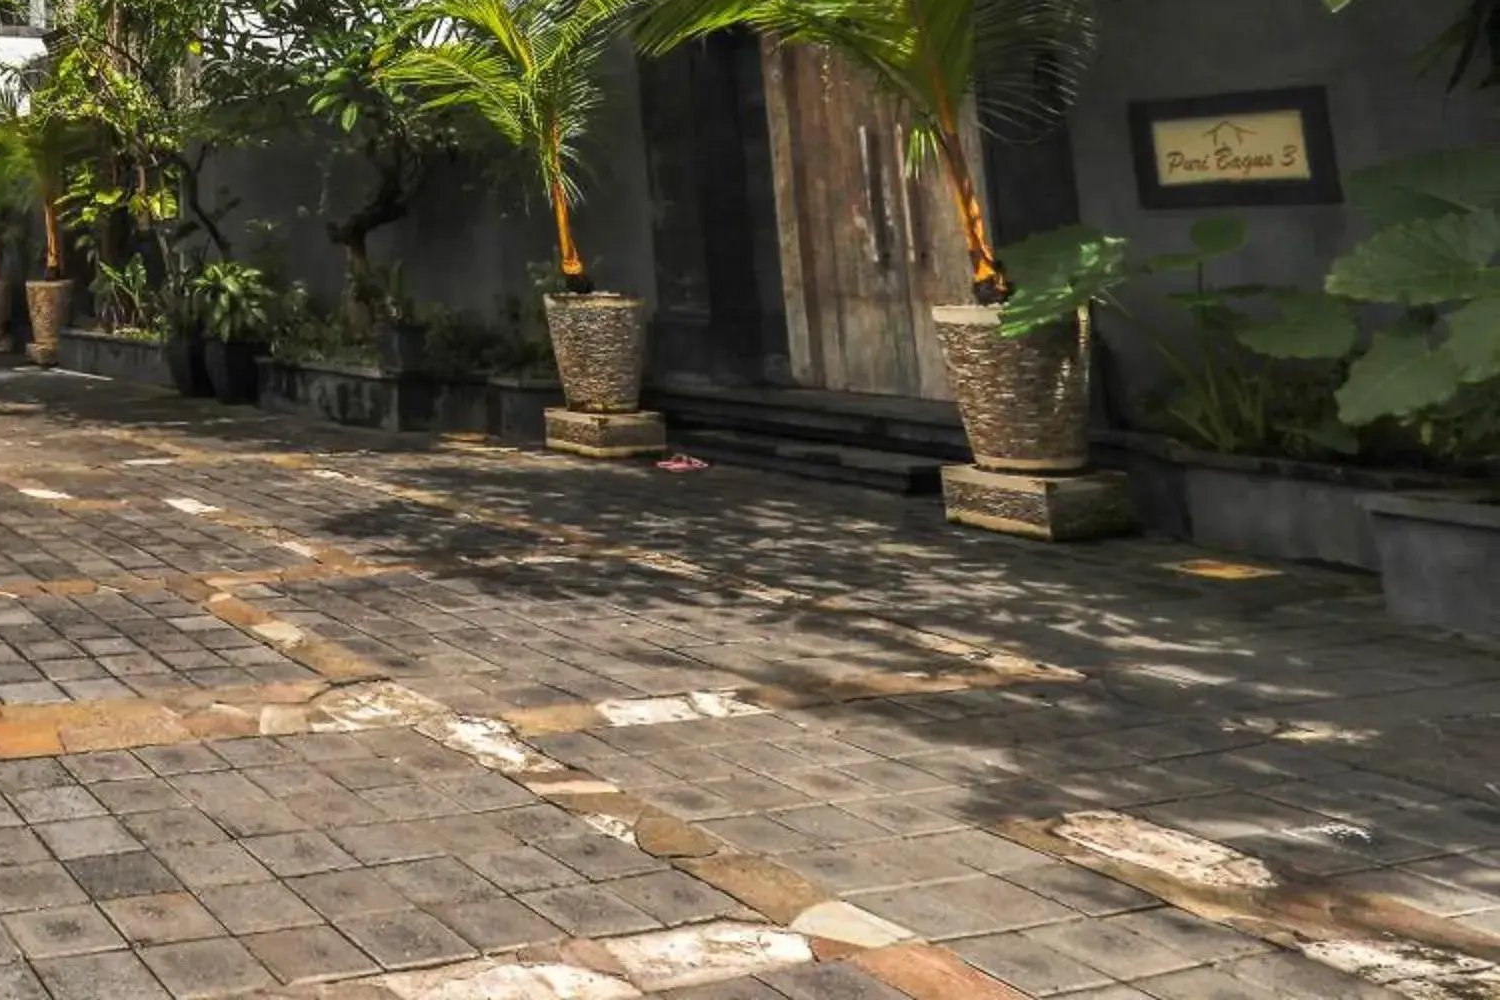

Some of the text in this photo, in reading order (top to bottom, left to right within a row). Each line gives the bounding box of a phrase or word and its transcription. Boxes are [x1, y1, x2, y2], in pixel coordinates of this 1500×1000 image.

[1166, 143, 1298, 174] Puri Bagus 3
